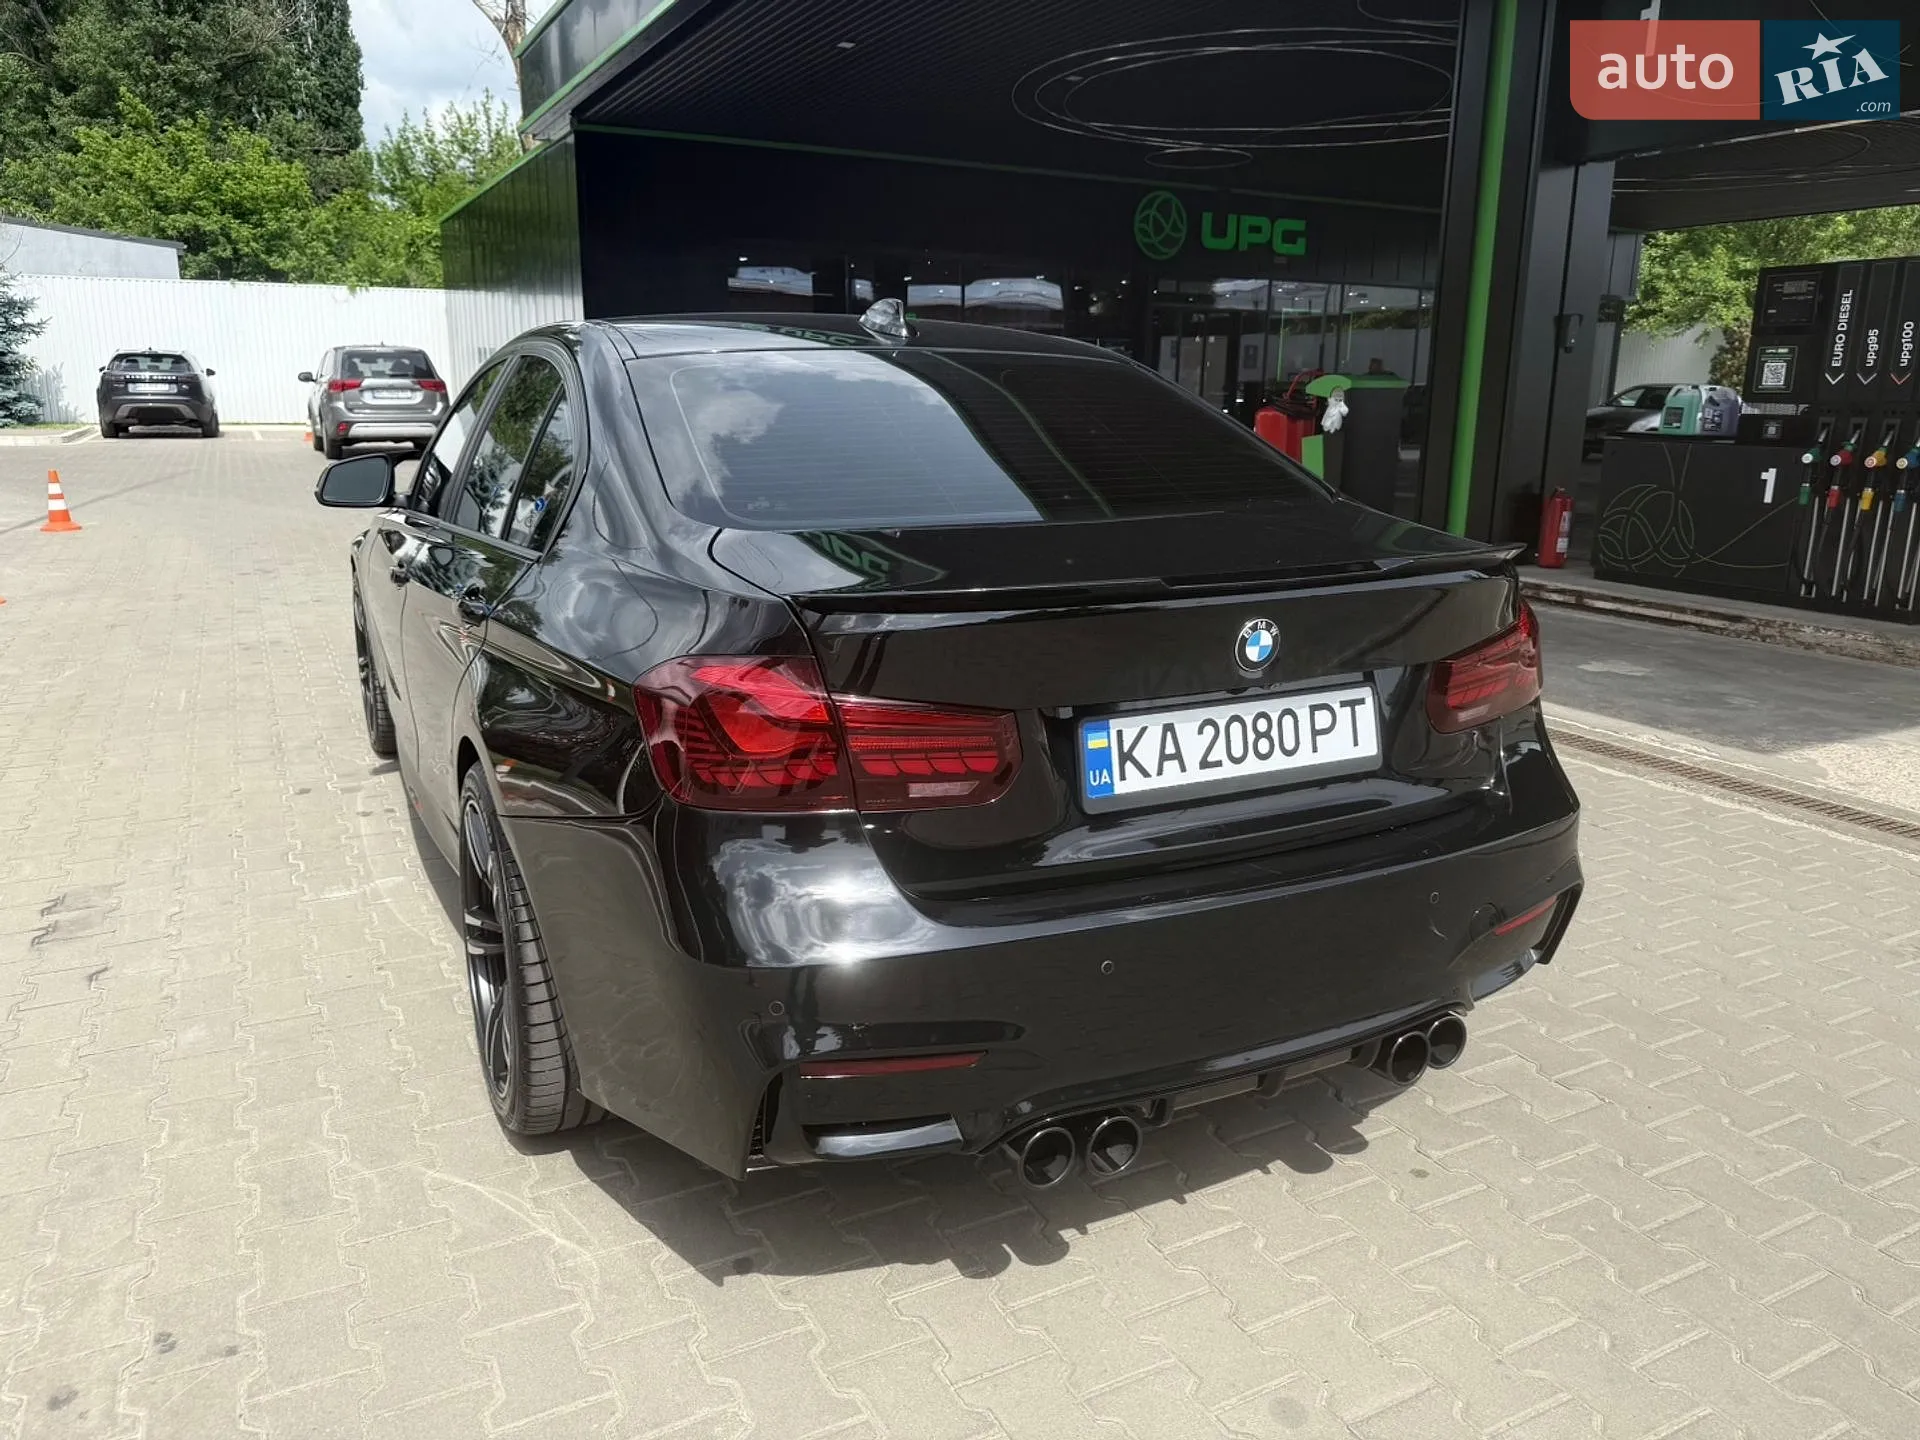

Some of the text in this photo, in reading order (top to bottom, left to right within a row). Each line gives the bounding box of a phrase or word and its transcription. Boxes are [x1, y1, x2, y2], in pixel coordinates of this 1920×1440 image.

[1201, 211, 1307, 256] UPG
[1831, 289, 1853, 367] EURO DIESEL
[1865, 328, 1879, 367] upg95
[1899, 321, 1914, 367] upg100
[1760, 468, 1777, 504] 1
[1242, 620, 1280, 638] BMW
[1116, 697, 1367, 782] KA 2080 PT
[1089, 769, 1112, 786] UA
